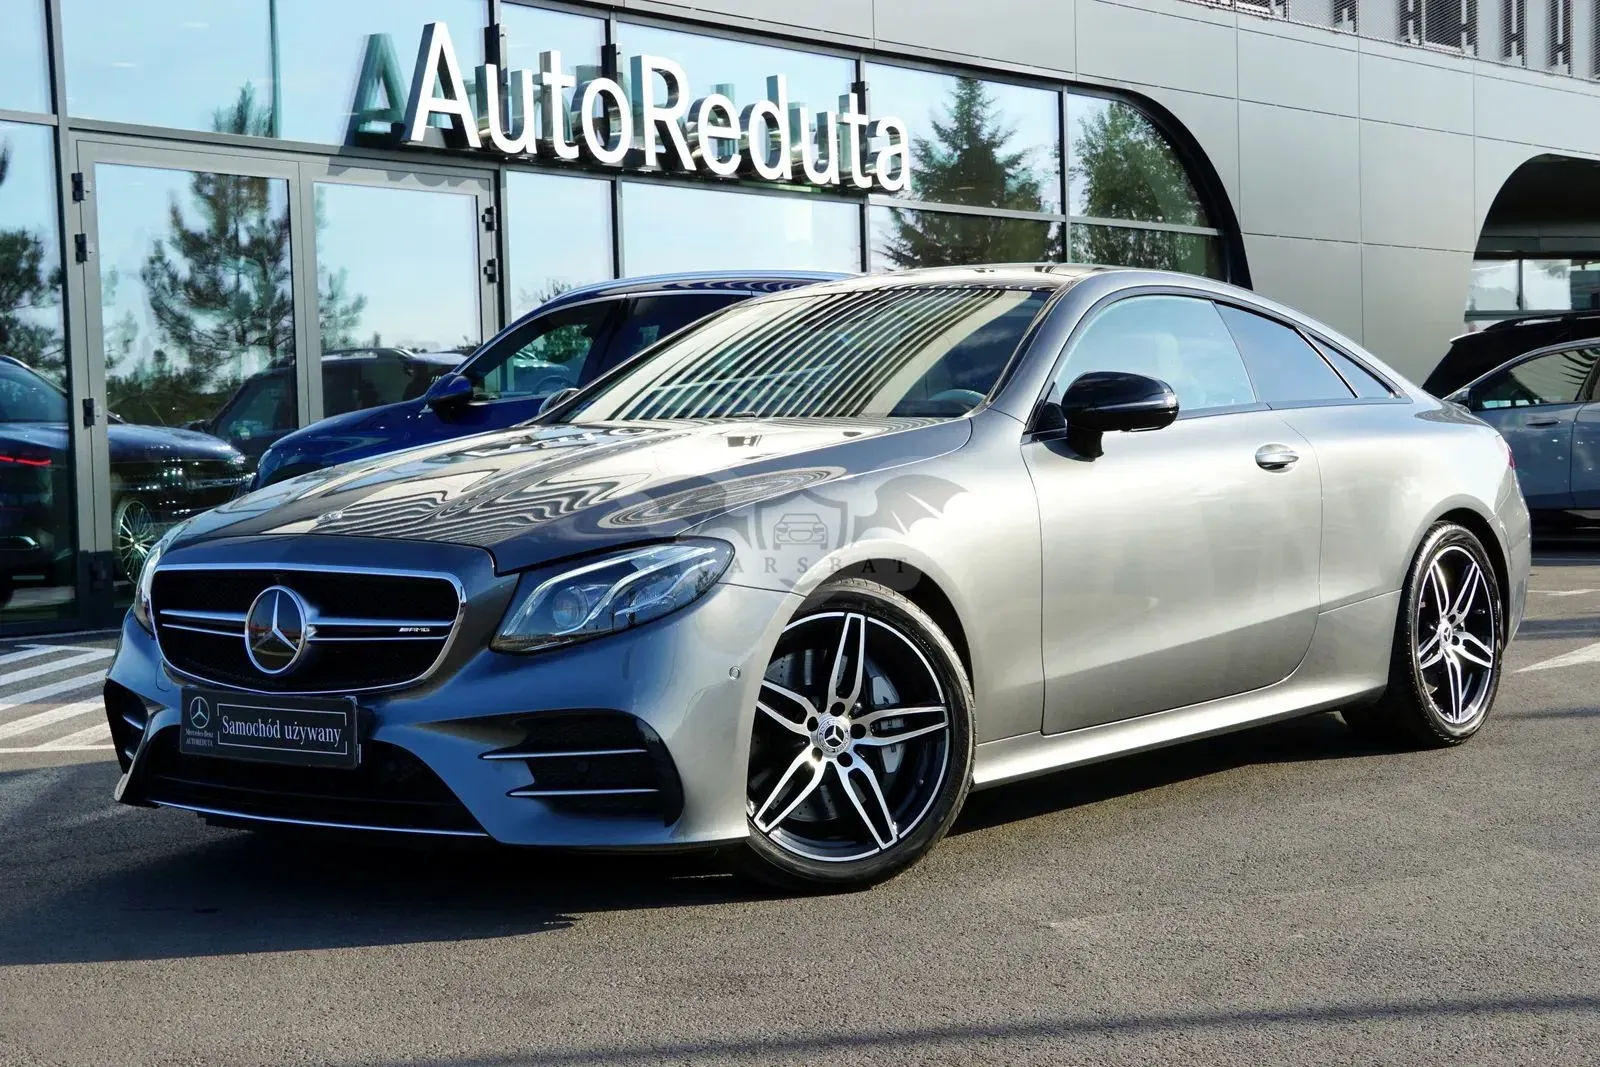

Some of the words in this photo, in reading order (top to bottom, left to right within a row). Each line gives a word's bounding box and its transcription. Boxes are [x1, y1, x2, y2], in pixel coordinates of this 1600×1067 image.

[407, 22, 911, 191] AutoReduta
[222, 715, 280, 739] Samochód
[285, 721, 342, 748] używany
